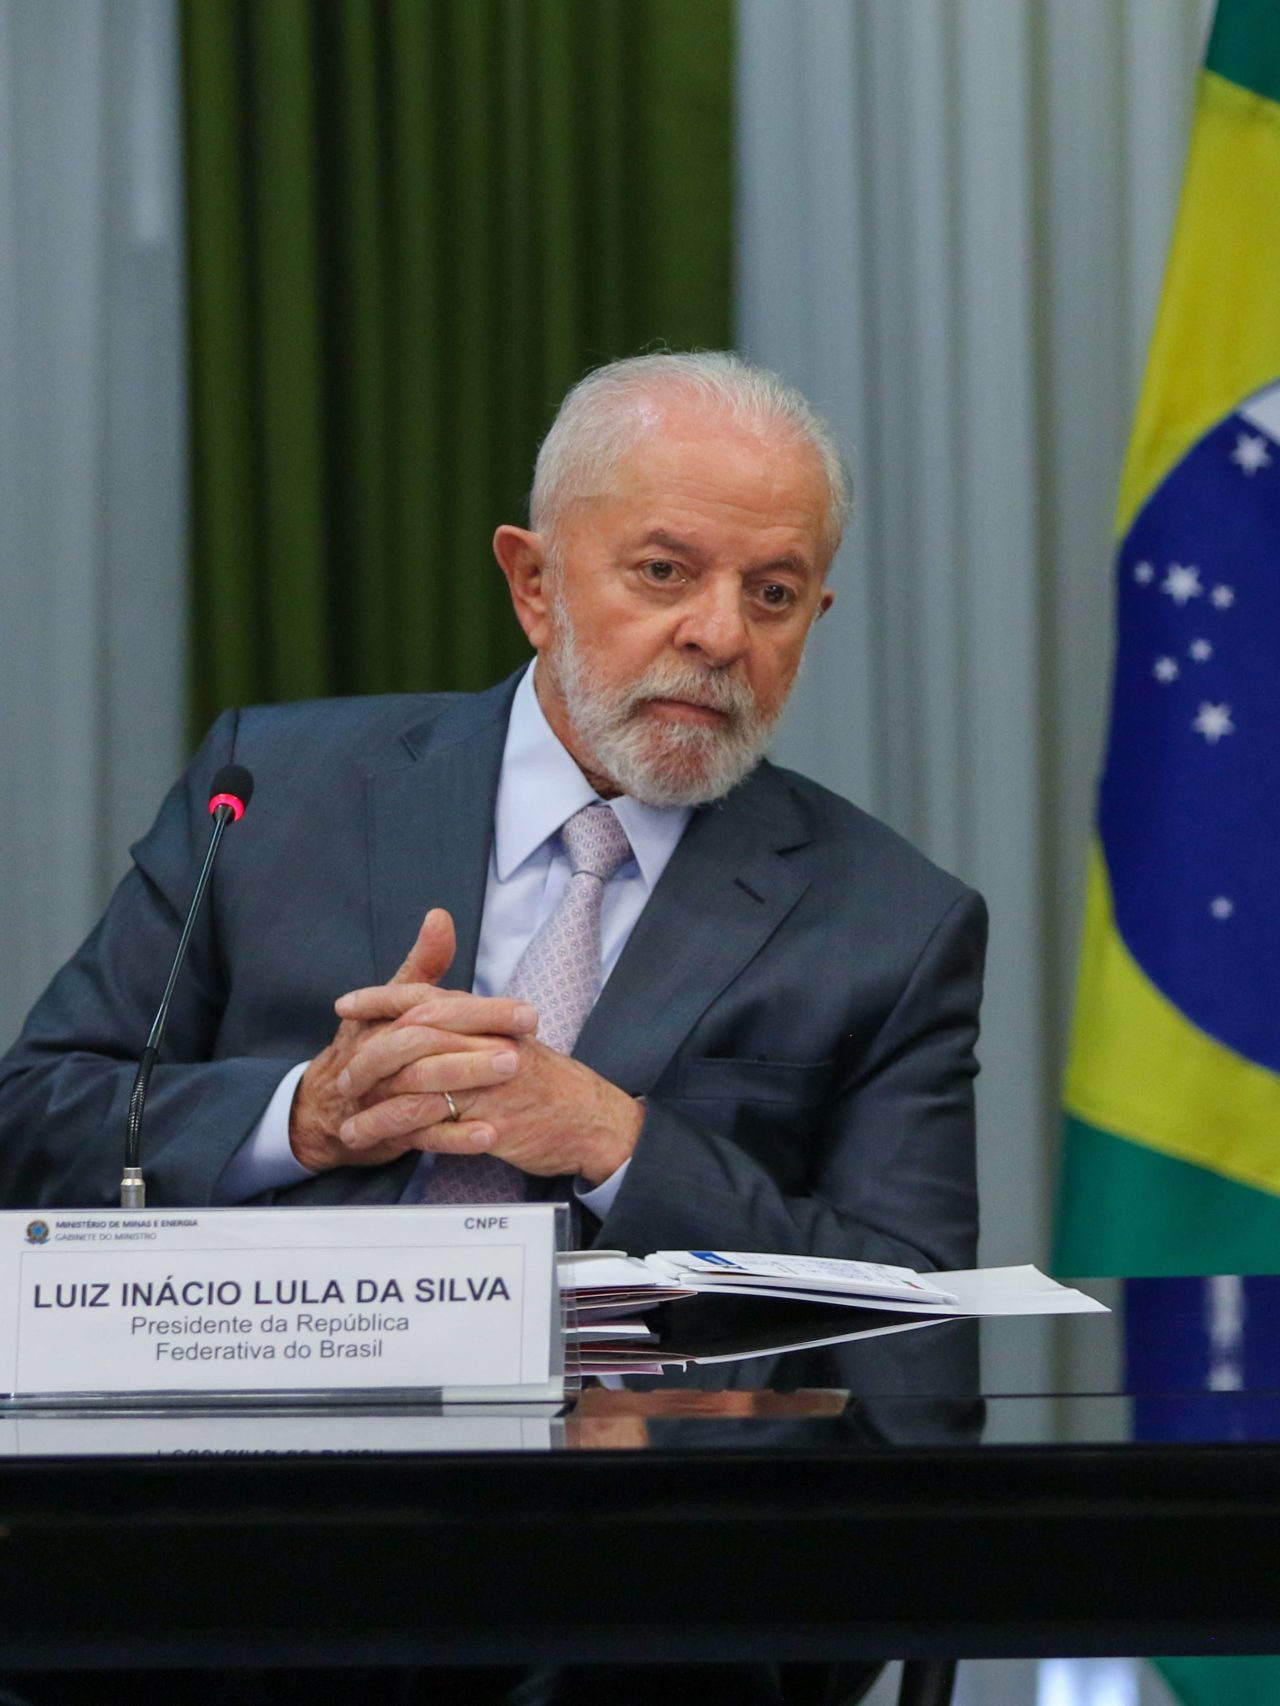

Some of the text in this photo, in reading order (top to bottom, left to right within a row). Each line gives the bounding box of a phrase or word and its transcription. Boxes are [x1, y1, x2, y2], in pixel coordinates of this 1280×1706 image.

[108, 1219, 121, 1228] DE
[122, 1219, 152, 1228] MINAS
[160, 1218, 199, 1228] ENERGIA
[464, 1216, 509, 1231] CNPE
[55, 1232, 99, 1241] GABINETE
[114, 1231, 158, 1241] MINISTRO
[34, 1275, 511, 1308] LUIZ INÁCIO LULA DA SILVA
[131, 1312, 410, 1336] Presidente da República
[156, 1338, 383, 1361] Federativa do Brasil
